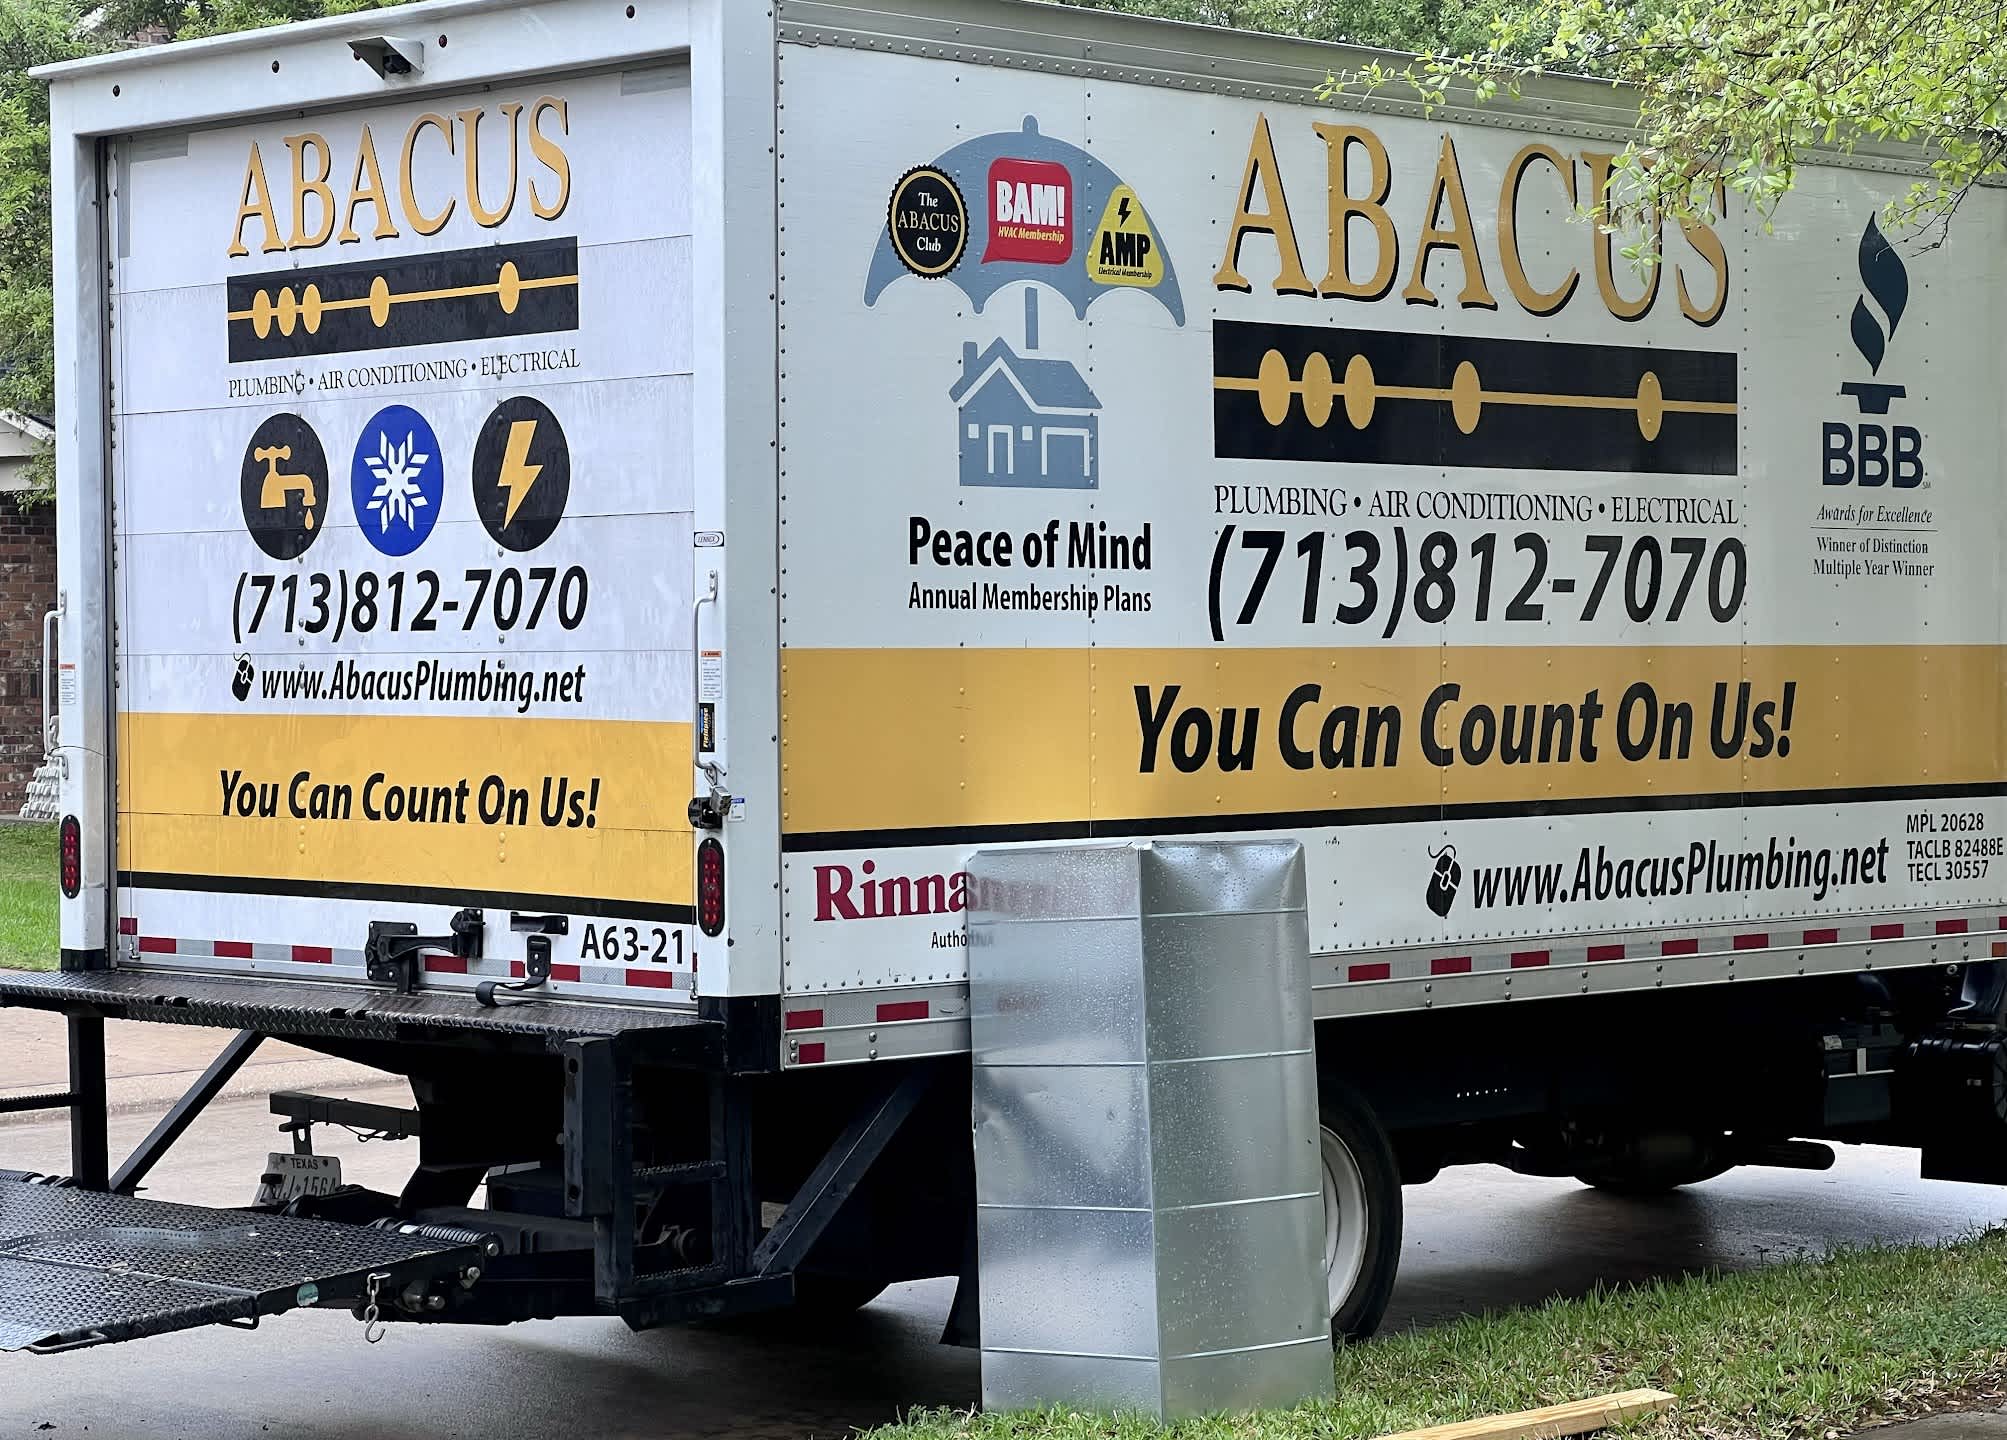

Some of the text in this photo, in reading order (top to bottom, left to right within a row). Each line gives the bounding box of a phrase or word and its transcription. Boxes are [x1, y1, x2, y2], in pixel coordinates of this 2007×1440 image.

[227, 95, 571, 257] ABACUS
[918, 191, 938, 208] The
[996, 180, 1065, 227] BAM!
[897, 210, 960, 233] ABACUS
[998, 225, 1065, 245] HVAC Membership
[1213, 112, 1730, 328] ABACUS
[916, 236, 942, 253] Club
[1100, 230, 1151, 268] AMP
[228, 348, 581, 398] PLUMBING AIR CONDITIONING ELECTRICAL
[1822, 422, 1924, 489] BBB
[1214, 485, 1739, 525] PLUMBING AIR CONDITIONING ELECTRICAL
[1816, 504, 1933, 526] Awards for Excellence
[909, 516, 1152, 570] Peace of Mind
[1816, 536, 1929, 554] Winner of Distinction
[1208, 524, 1748, 642] (713)812-7070
[1813, 559, 1935, 579] Multiple Year Winner
[232, 565, 589, 644] (713)812-7070
[908, 581, 1152, 619] Annual Membership Plans
[261, 659, 586, 714] www.AbacusPlumbing.net
[1133, 680, 1798, 774] You Can Count On Us!
[219, 769, 601, 829] You Can Count On Us!
[1906, 812, 1984, 834] MPL 20628
[1906, 837, 2004, 860] TACLB 82488E
[813, 859, 967, 922] Rinna
[1472, 836, 1890, 909] www.AbacusPlumbing.net
[1907, 860, 1989, 882] TECL 30557
[580, 923, 683, 965] A63-21
[931, 931, 967, 949] Autho
[290, 1157, 319, 1170] TEXAS
